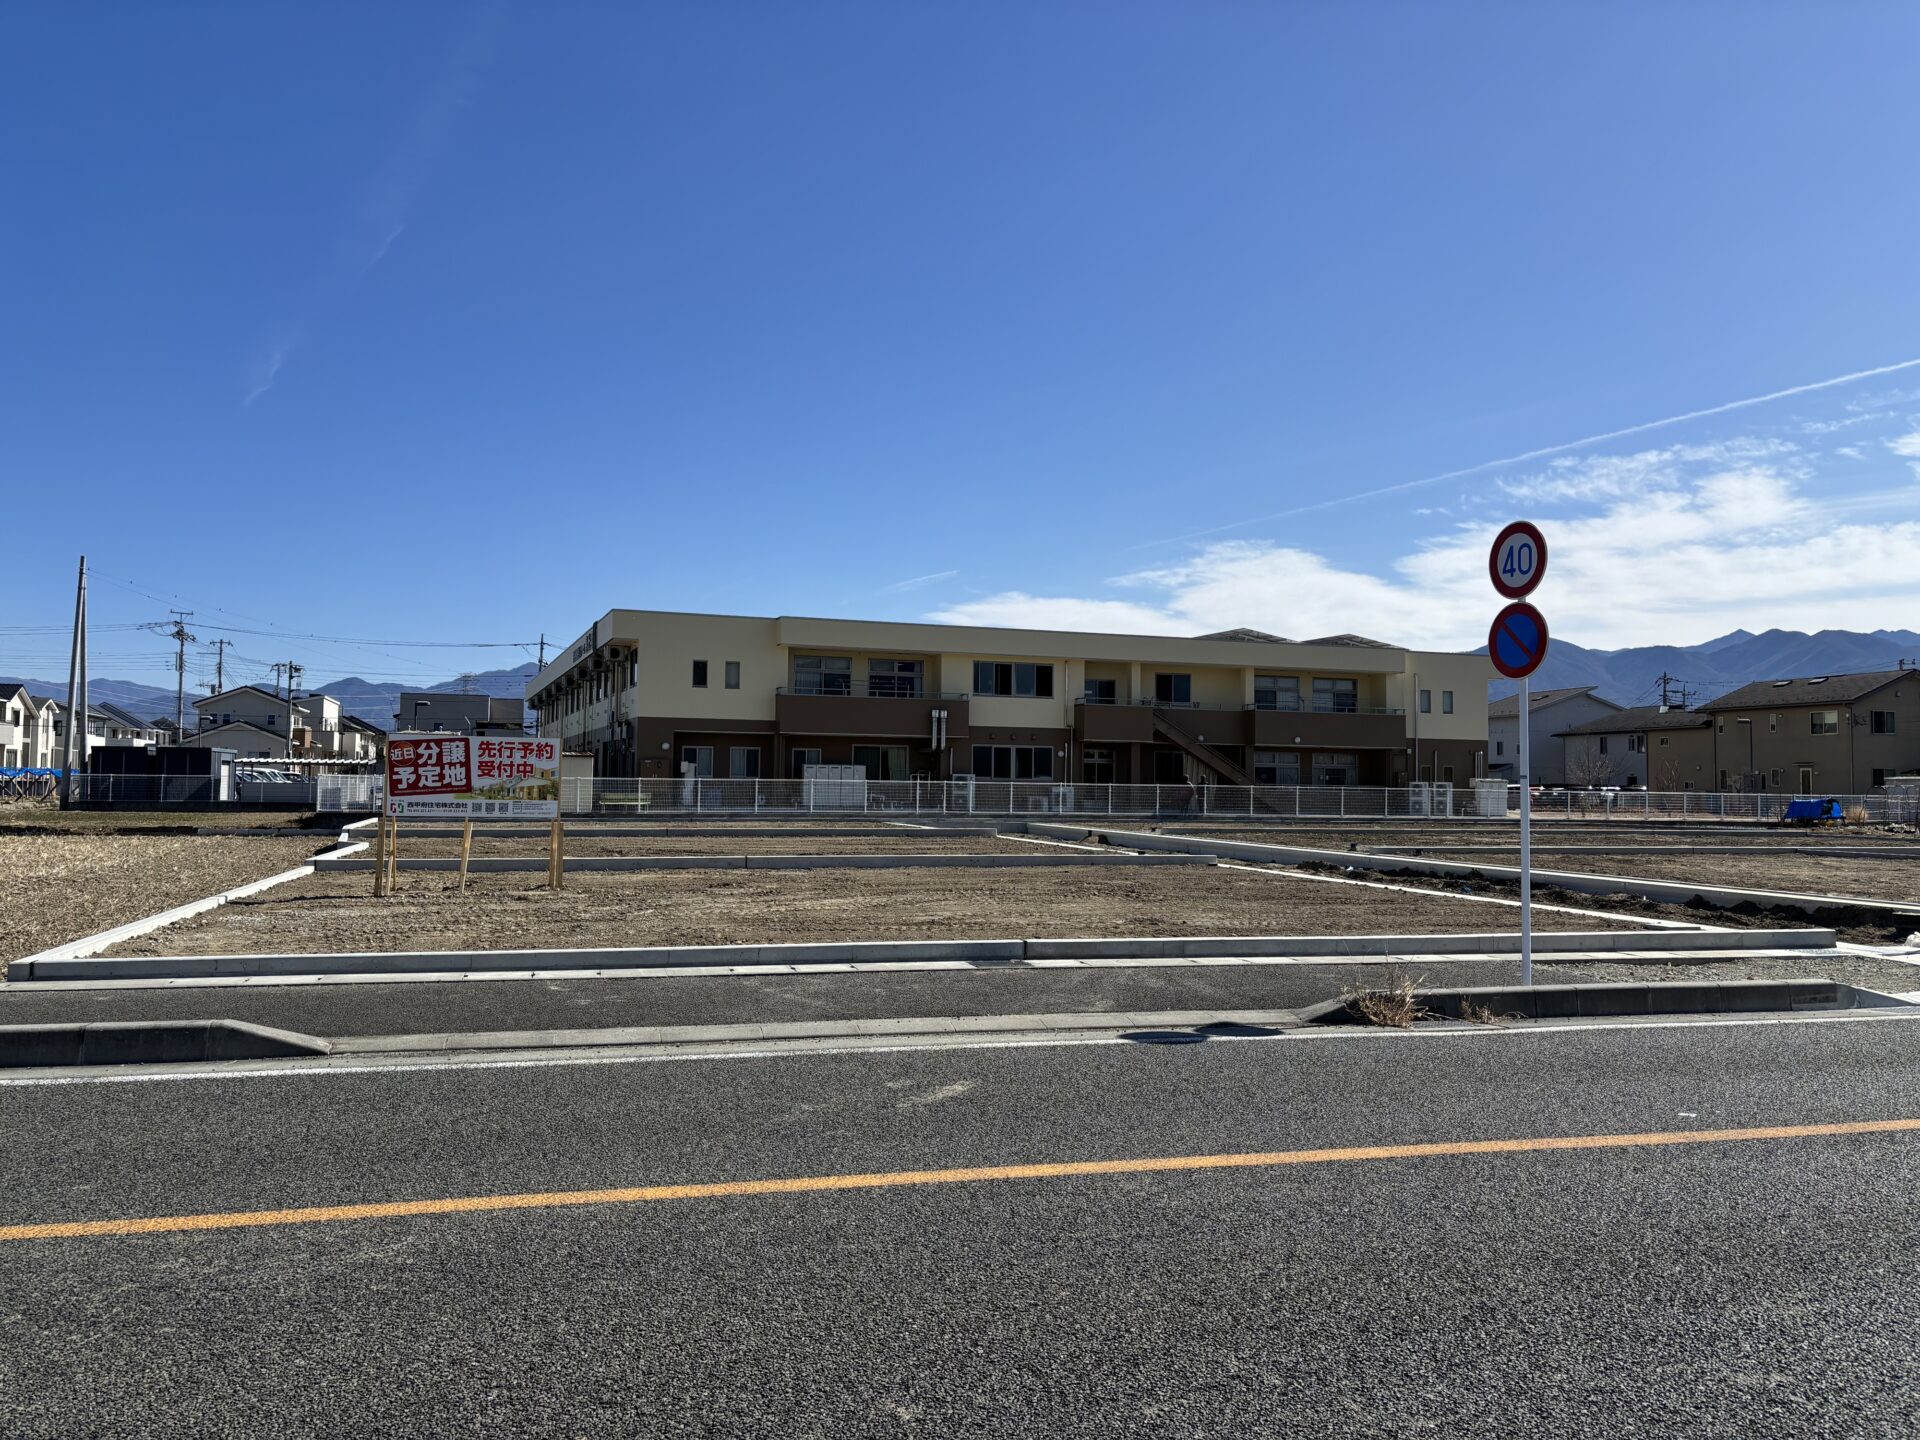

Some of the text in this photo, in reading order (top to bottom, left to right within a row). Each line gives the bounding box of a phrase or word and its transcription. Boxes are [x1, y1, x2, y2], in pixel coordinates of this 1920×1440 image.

[1502, 542, 1533, 578] 40
[390, 741, 466, 764] 近日 分譲
[477, 740, 554, 761] 先行予約
[392, 764, 467, 789] 予定地
[477, 760, 535, 779] 受付中
